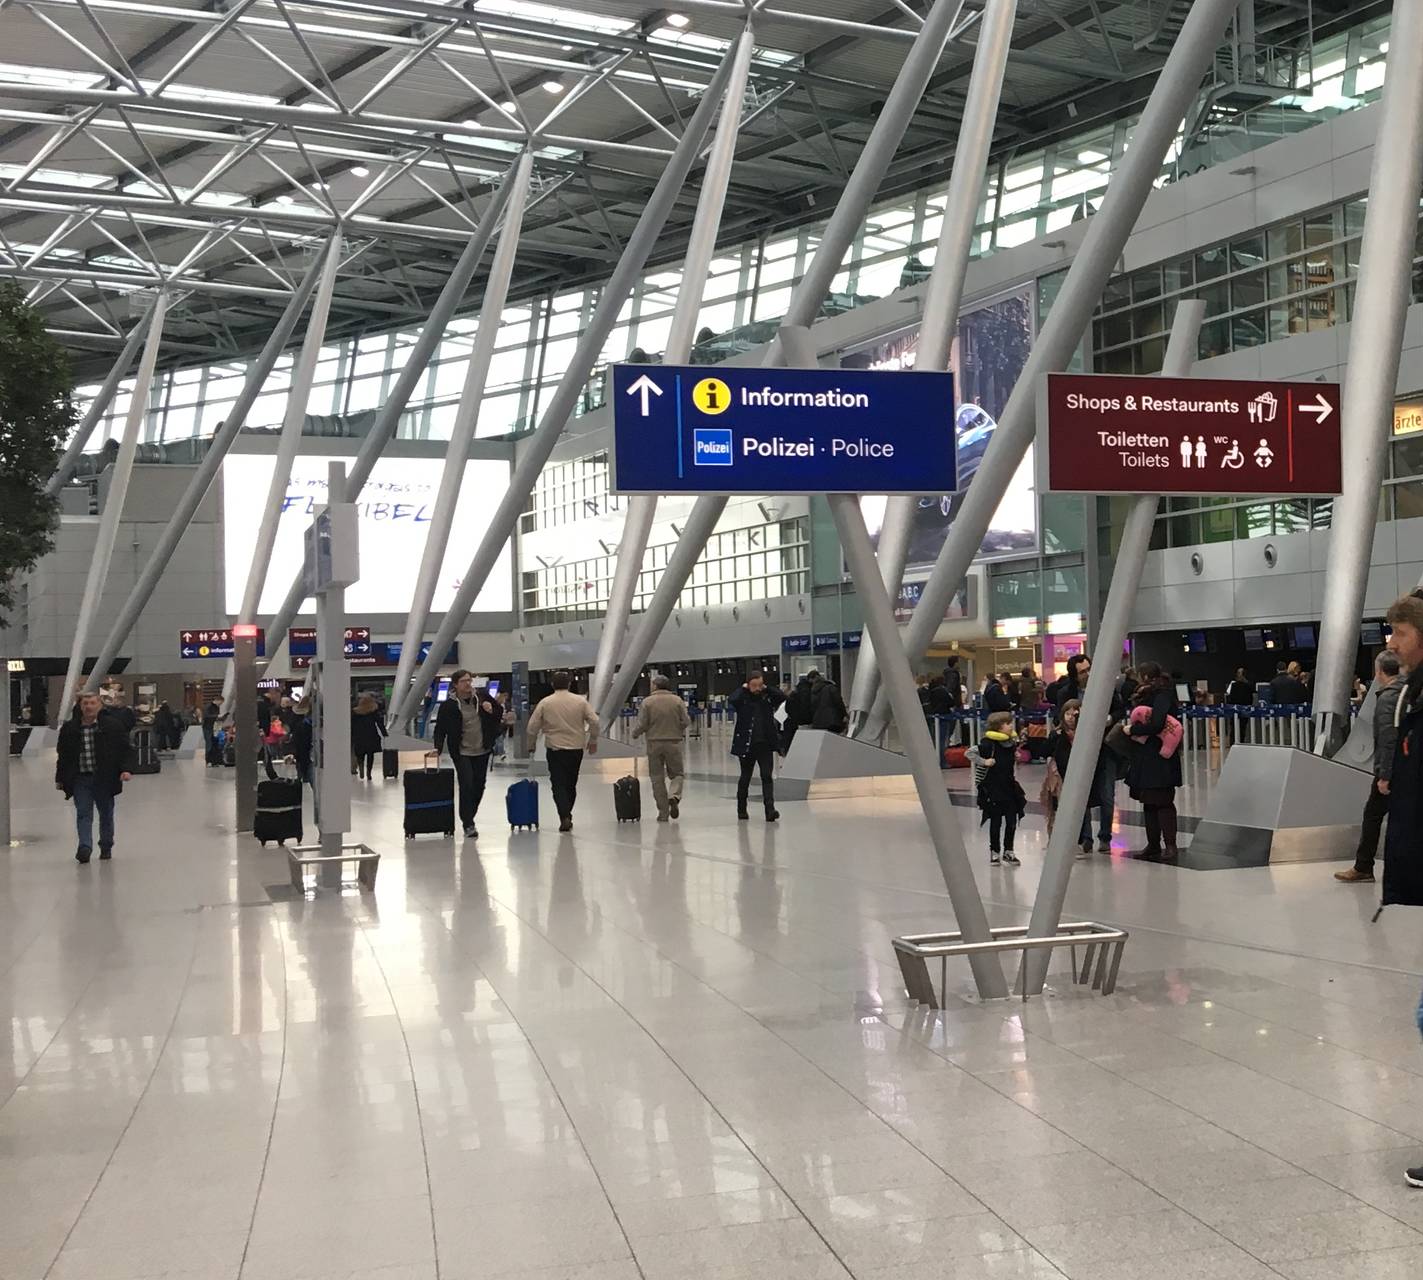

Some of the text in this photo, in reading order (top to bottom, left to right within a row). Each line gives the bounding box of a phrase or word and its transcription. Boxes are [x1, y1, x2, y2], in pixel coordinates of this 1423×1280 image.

[741, 387, 869, 408] Information
[1066, 393, 1240, 414] Shops & Restaurants
[1395, 414, 1422, 430] ärzte
[697, 441, 730, 455] Polizei
[742, 437, 895, 458] Polizei Police
[1097, 431, 1170, 448] Toiletten
[1213, 436, 1229, 445] WC
[1118, 451, 1170, 468] Toilets
[280, 495, 433, 522] FLIBEL
